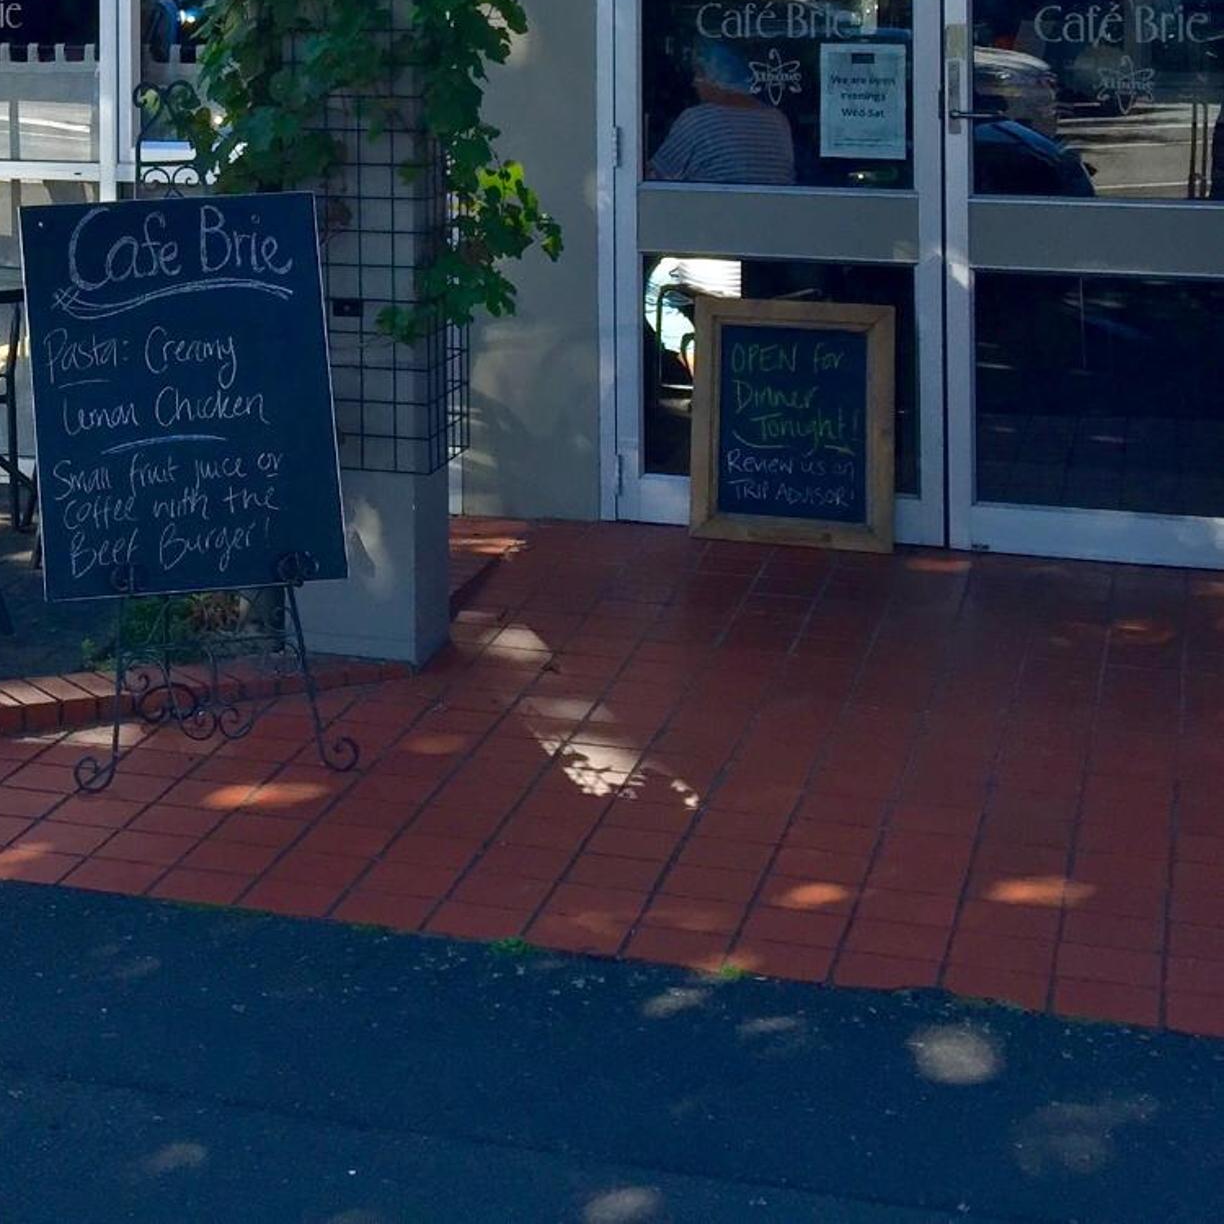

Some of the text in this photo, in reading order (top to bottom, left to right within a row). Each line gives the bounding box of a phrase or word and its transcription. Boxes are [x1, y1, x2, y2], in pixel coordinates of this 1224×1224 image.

[696, 1, 860, 39] Café Brie
[1034, 3, 1211, 44] Café Brie
[68, 204, 293, 289] Cafe Brie
[44, 326, 238, 390] Pasta: Creamy
[731, 342, 845, 374] OPEN for
[63, 385, 271, 436] Lemon Chicken
[732, 378, 819, 414] Dinner
[53, 452, 284, 501] Small fruit juice or
[727, 477, 769, 500] TRIP
[800, 457, 826, 476] us
[832, 461, 855, 481] on
[64, 485, 280, 530] Coffee with the
[69, 527, 139, 579] Beef
